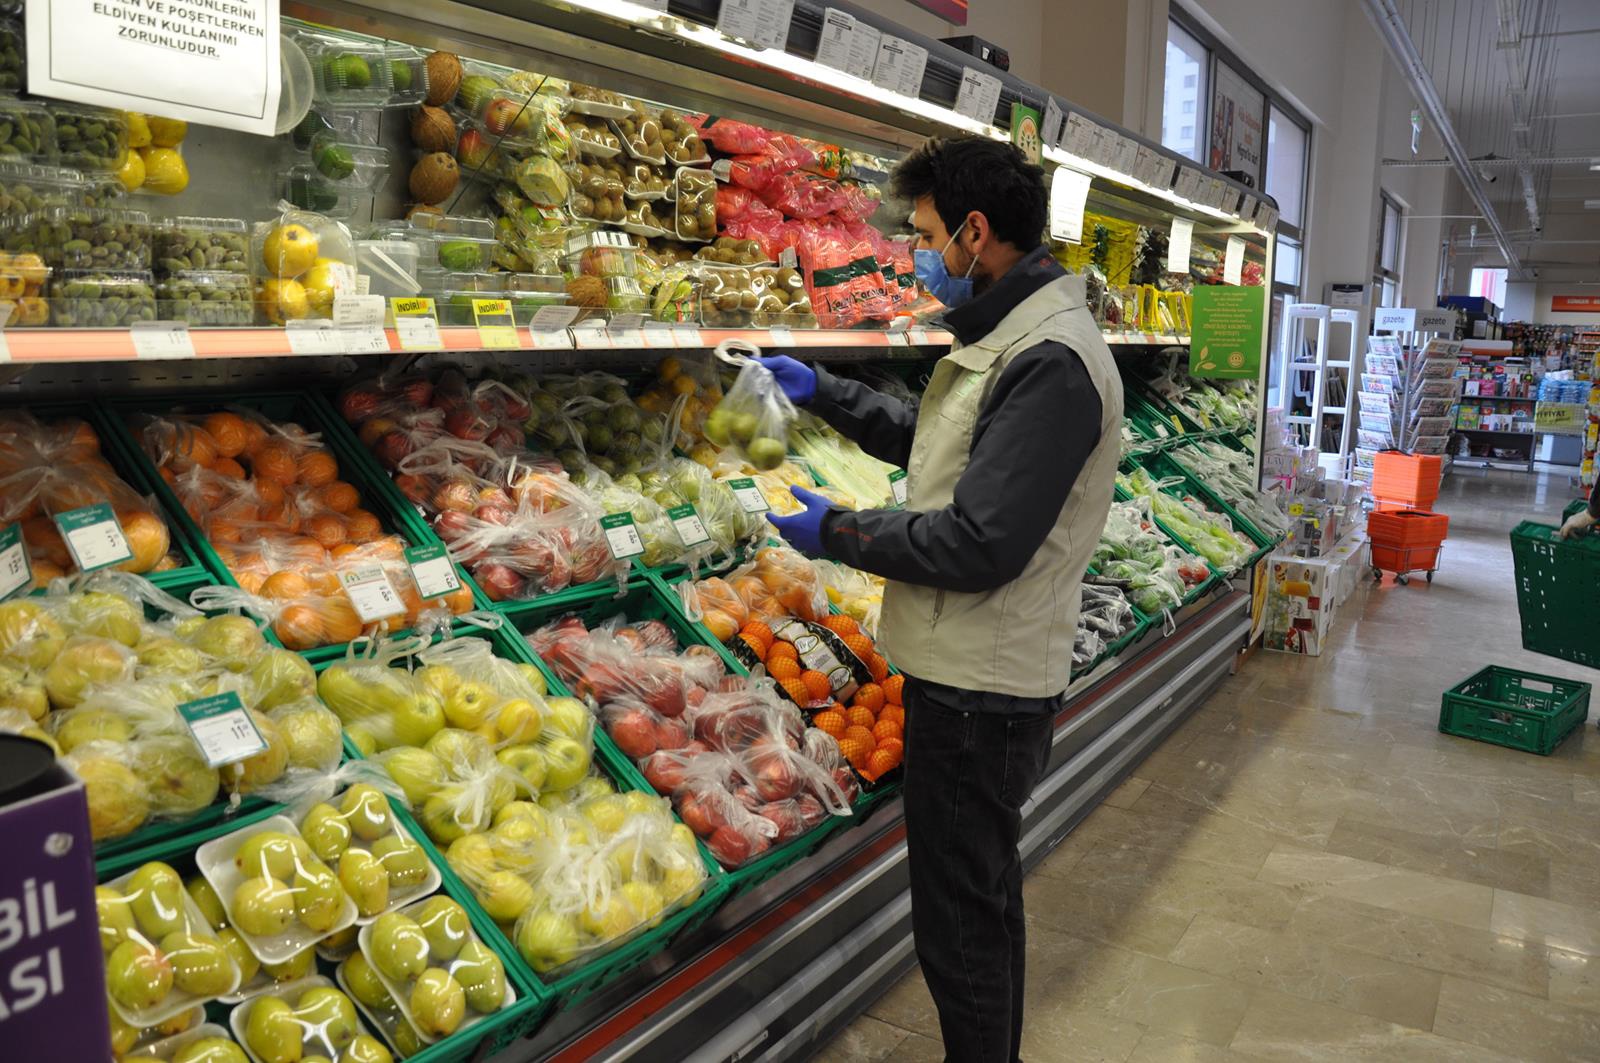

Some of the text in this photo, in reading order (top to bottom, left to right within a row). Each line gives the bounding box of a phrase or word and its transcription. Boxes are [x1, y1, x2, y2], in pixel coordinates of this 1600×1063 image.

[94, 2, 237, 46] ELDİVEN KULLANIMI
[146, 0, 264, 37] VE POŞETLERKEN
[118, 25, 220, 58] ZORUNLUDUR.
[1422, 317, 1447, 326] gazete
[0, 946, 64, 1021] SI
